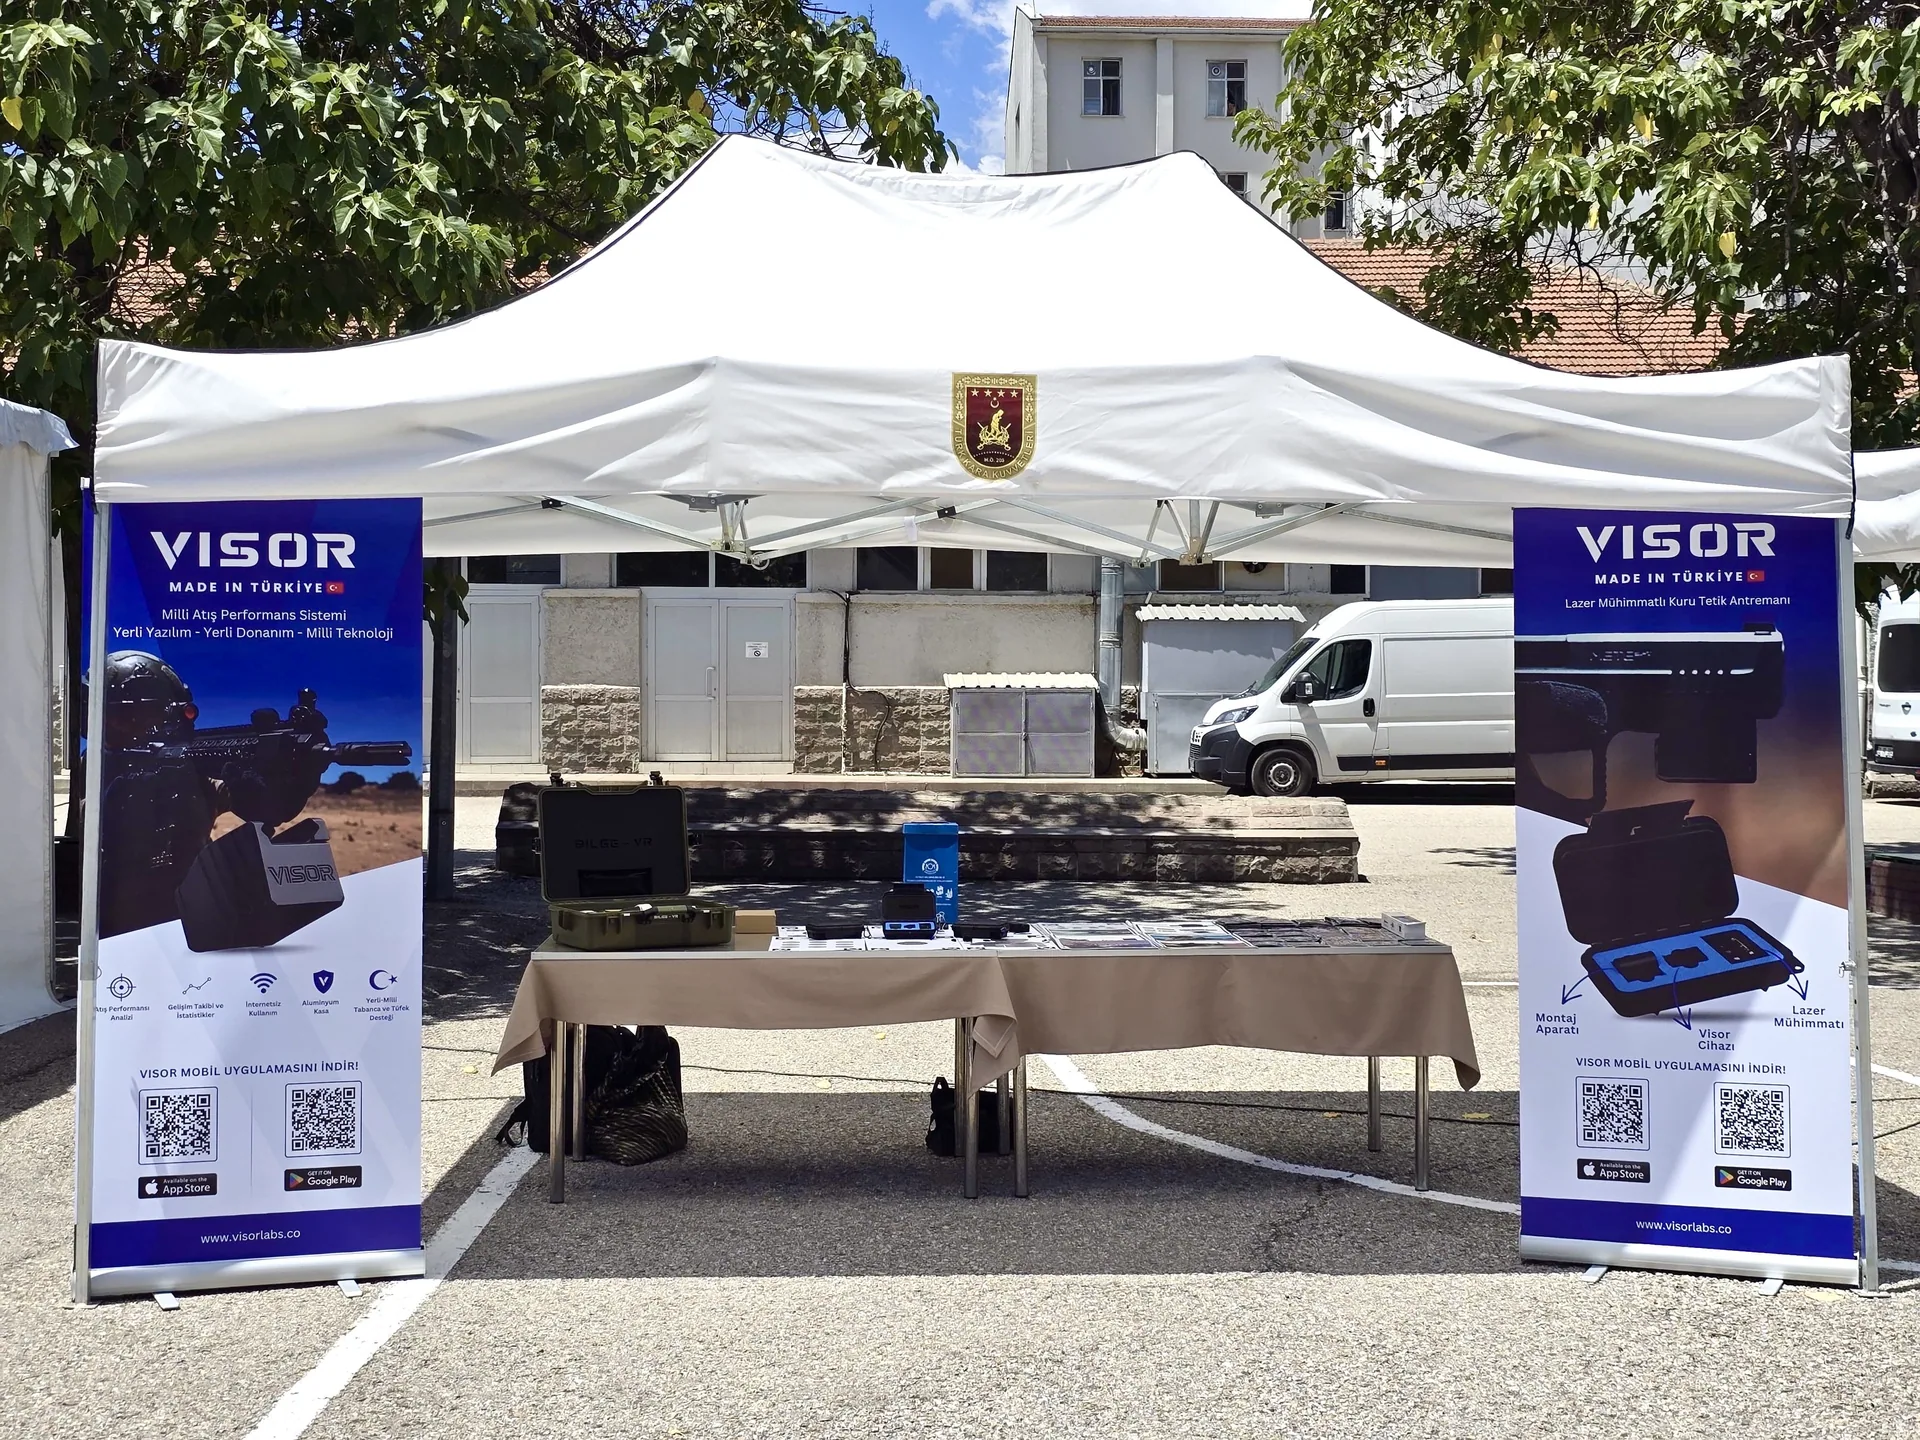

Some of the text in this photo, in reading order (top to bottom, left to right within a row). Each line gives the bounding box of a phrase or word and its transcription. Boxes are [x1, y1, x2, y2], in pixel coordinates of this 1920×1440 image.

[963, 459, 989, 478] KARA
[1576, 522, 1776, 563] VISOR
[150, 532, 356, 570] VISOR
[1595, 570, 1743, 584] MADE IN TÜRKİYE
[169, 579, 323, 593] MADE IN TÜRKİYE
[1565, 595, 1790, 609] Lazer Mühimmatlı Kuru Tetik Antremanı
[162, 609, 347, 623] Milli Atış Performans Sistemi
[113, 627, 143, 638] Yerli
[147, 627, 192, 638] Yazılım
[204, 627, 233, 638] Yerli
[237, 627, 294, 639] Donanım
[306, 628, 332, 639] Milli
[336, 628, 393, 641] Teknoloji
[268, 864, 336, 886] VISOR
[109, 1004, 150, 1012] Performansı
[168, 1003, 192, 1012] Gelişim
[194, 1002, 214, 1010] Takibi
[302, 999, 340, 1007] Aluminyum
[1792, 1005, 1825, 1016] Lazer
[369, 1014, 394, 1022] Desteği
[1535, 1013, 1577, 1025] Montaj
[1774, 1017, 1845, 1029] Mühimmatı
[1535, 1025, 1579, 1036] Aparatı
[1699, 1029, 1730, 1039] Visor
[1698, 1040, 1735, 1051] Cihazı
[140, 1060, 359, 1079] VISOR MOBİL UYGULAMASINI İNDİR!
[1576, 1057, 1786, 1074] VISOR MOBİL UYGULAMASINI İNDİR!
[1600, 1168, 1644, 1180] App Store
[308, 1175, 358, 1187] Google Play
[1737, 1176, 1787, 1188] Google Play
[163, 1184, 210, 1196] App Store
[1636, 1220, 1732, 1234] www.visorlabs.co
[200, 1229, 301, 1244] www.visorlabs.co
